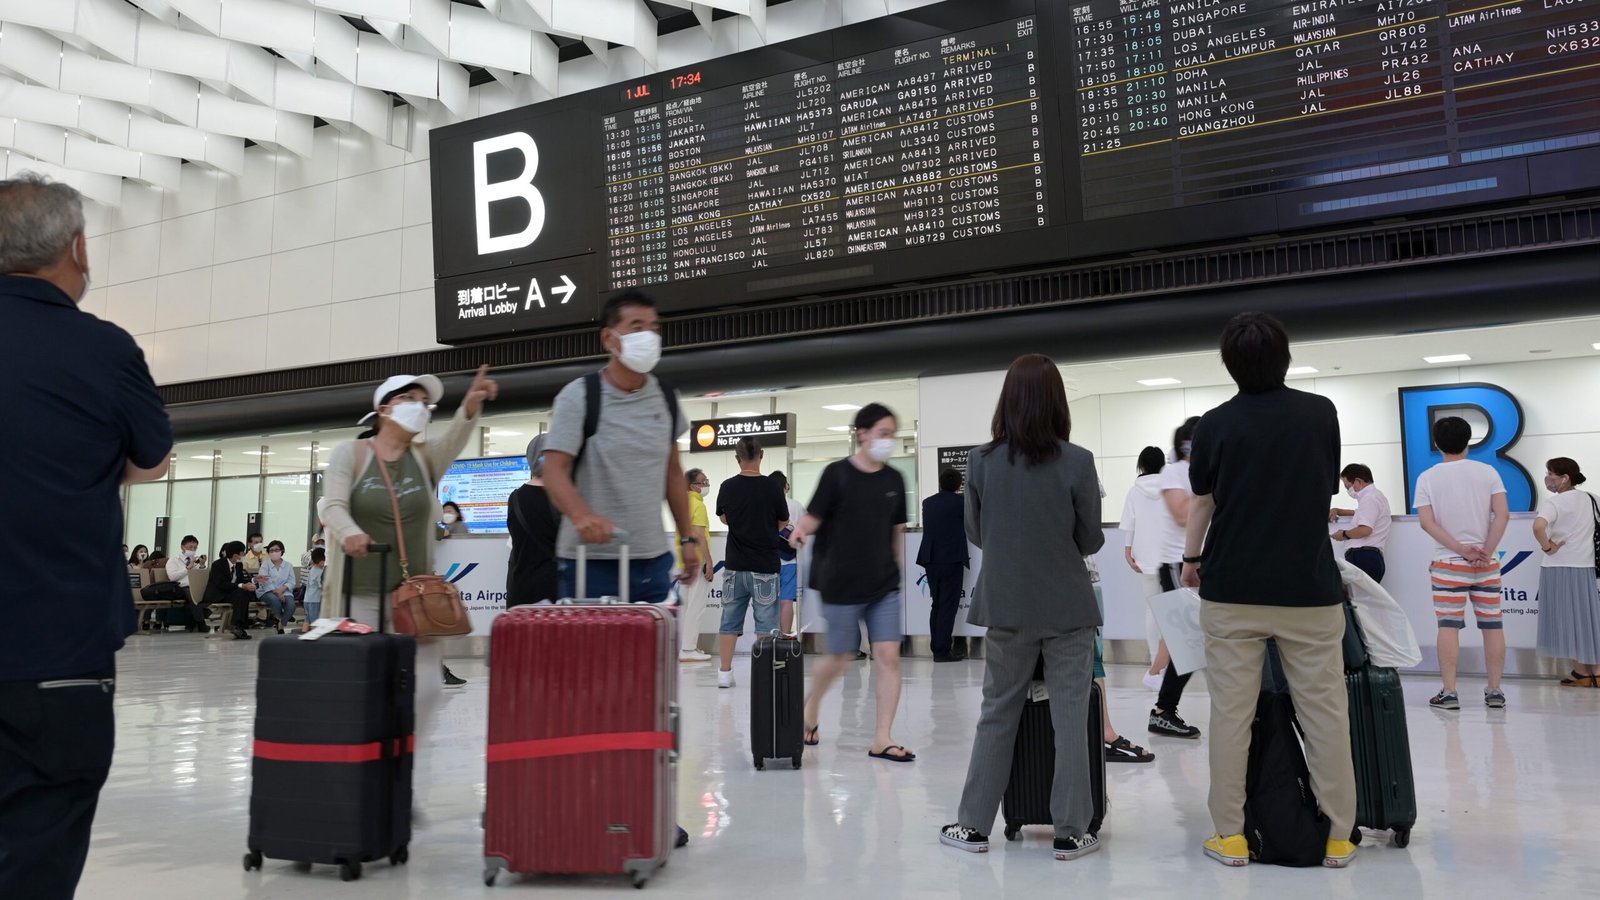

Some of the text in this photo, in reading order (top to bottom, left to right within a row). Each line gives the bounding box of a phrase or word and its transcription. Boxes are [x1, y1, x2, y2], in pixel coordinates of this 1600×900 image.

[1017, 19, 1033, 30] 出口
[1074, 13, 1093, 24] TIME
[1077, 20, 1112, 35] 16:55
[1123, 10, 1160, 24] 16:48
[1078, 3, 1246, 48] 17:30 17:19 SINGAPORE
[1079, 46, 1114, 61] 17:35
[1125, 36, 1162, 51] 18:05
[1173, 25, 1211, 41] DUBAI
[1080, 13, 1334, 74] 17:50 17:11 LOS ANGELES AIR-INDIA
[1081, 11, 1414, 87] 18:05 18:00 KUALA LUMPUR MALAYSIAN MH70
[626, 72, 702, 100] 1 JUL 17:34
[838, 27, 1033, 78] AIRLINE REMARKS EXIT
[1082, 7, 1521, 100] 18:35 21:10 DOHA QATAR QR806 LATAM Airlines
[1082, 39, 1426, 113] 19:55 20:30 MANILA JAL JL742
[1082, 112, 1119, 127] 20:10
[1130, 103, 1166, 117] 19:50
[1178, 92, 1227, 108] MANILA
[1297, 69, 1348, 86] PHILIPPINES
[1382, 54, 1428, 70] PR432
[1453, 44, 1481, 57] ANA
[606, 129, 629, 140] 13:30
[637, 122, 660, 133] 13:19
[668, 116, 693, 127] SEOUL
[744, 101, 760, 110] JAL
[796, 84, 830, 98] JL5202
[943, 48, 996, 65] TERMINAL
[607, 60, 991, 150] 16:05 15:56 JAKARTA JAL JL720 AMERICAN AA8497 ARRIVED
[607, 73, 992, 161] 16:05 15:56 JAKARTA HAWAIIAN HA5373 GARUDA GA9150 ARRIVED
[1083, 125, 1119, 140] 20:45
[1129, 117, 1167, 131] 20:40
[1179, 109, 1211, 122] HONG
[1221, 100, 1254, 114] KONG
[1301, 88, 1325, 100] JAL
[1384, 70, 1419, 84] JL26
[1454, 52, 1513, 71] CATHAY
[1084, 85, 1421, 153] 21:25 GUANGZHOU JAL JL88
[608, 155, 662, 172] 16:15 15:46
[609, 110, 994, 193] 16:20 16:19 BANGKOK (BKK) JAL JL708 AMERICAN AA8412 CUSTOMS
[473, 132, 545, 255] B
[611, 161, 997, 235] 16:35 16:39 HONG KONG CATHAY CX520 AMERICAN AA8882 CUSTOMS
[611, 173, 998, 246] 16:40 16:32 LOS ANGELES JAL JL61 AMERICAN AA8407 CUSTOMS
[612, 211, 1000, 278] 16:45 16:24 SAN FRANCISCO JAL JL57 AMERICAN AA8410 CUSTOMS
[613, 224, 1001, 288] 16:50 16:43 DALIAN JAL JL820 MU8729 CUSTOMS
[458, 283, 520, 306] 到着ロビー
[458, 302, 517, 319] Arrival Lobby
[524, 278, 546, 310] A
[718, 422, 761, 434] 入れません
[1398, 382, 1538, 515] B
